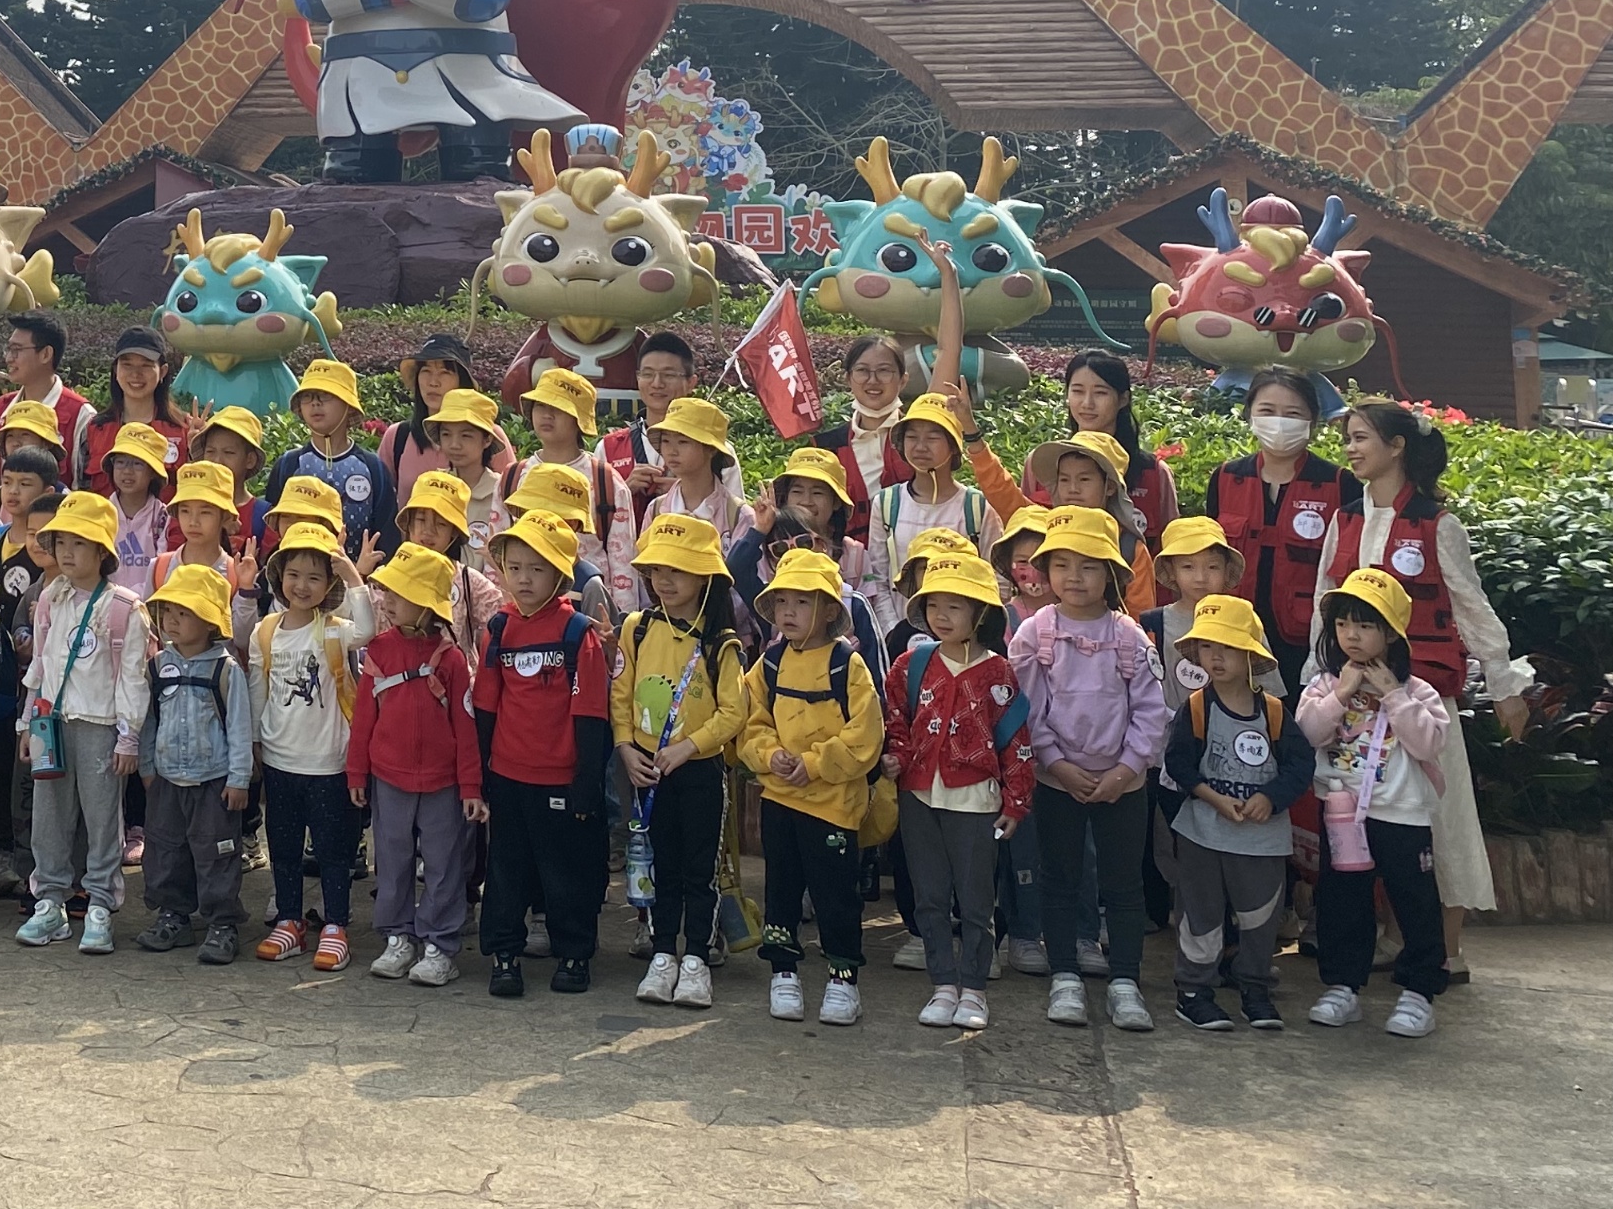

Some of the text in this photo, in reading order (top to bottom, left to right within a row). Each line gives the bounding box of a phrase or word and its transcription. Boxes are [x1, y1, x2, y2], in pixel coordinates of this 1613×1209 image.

[558, 382, 581, 397] ART
[294, 488, 321, 499] ART
[429, 480, 458, 495] ART
[559, 485, 584, 499] ART
[528, 517, 557, 533] ART
[1047, 517, 1073, 530] ART
[655, 526, 685, 536] ART
[928, 563, 961, 573] ART
[1194, 607, 1219, 618] ART
